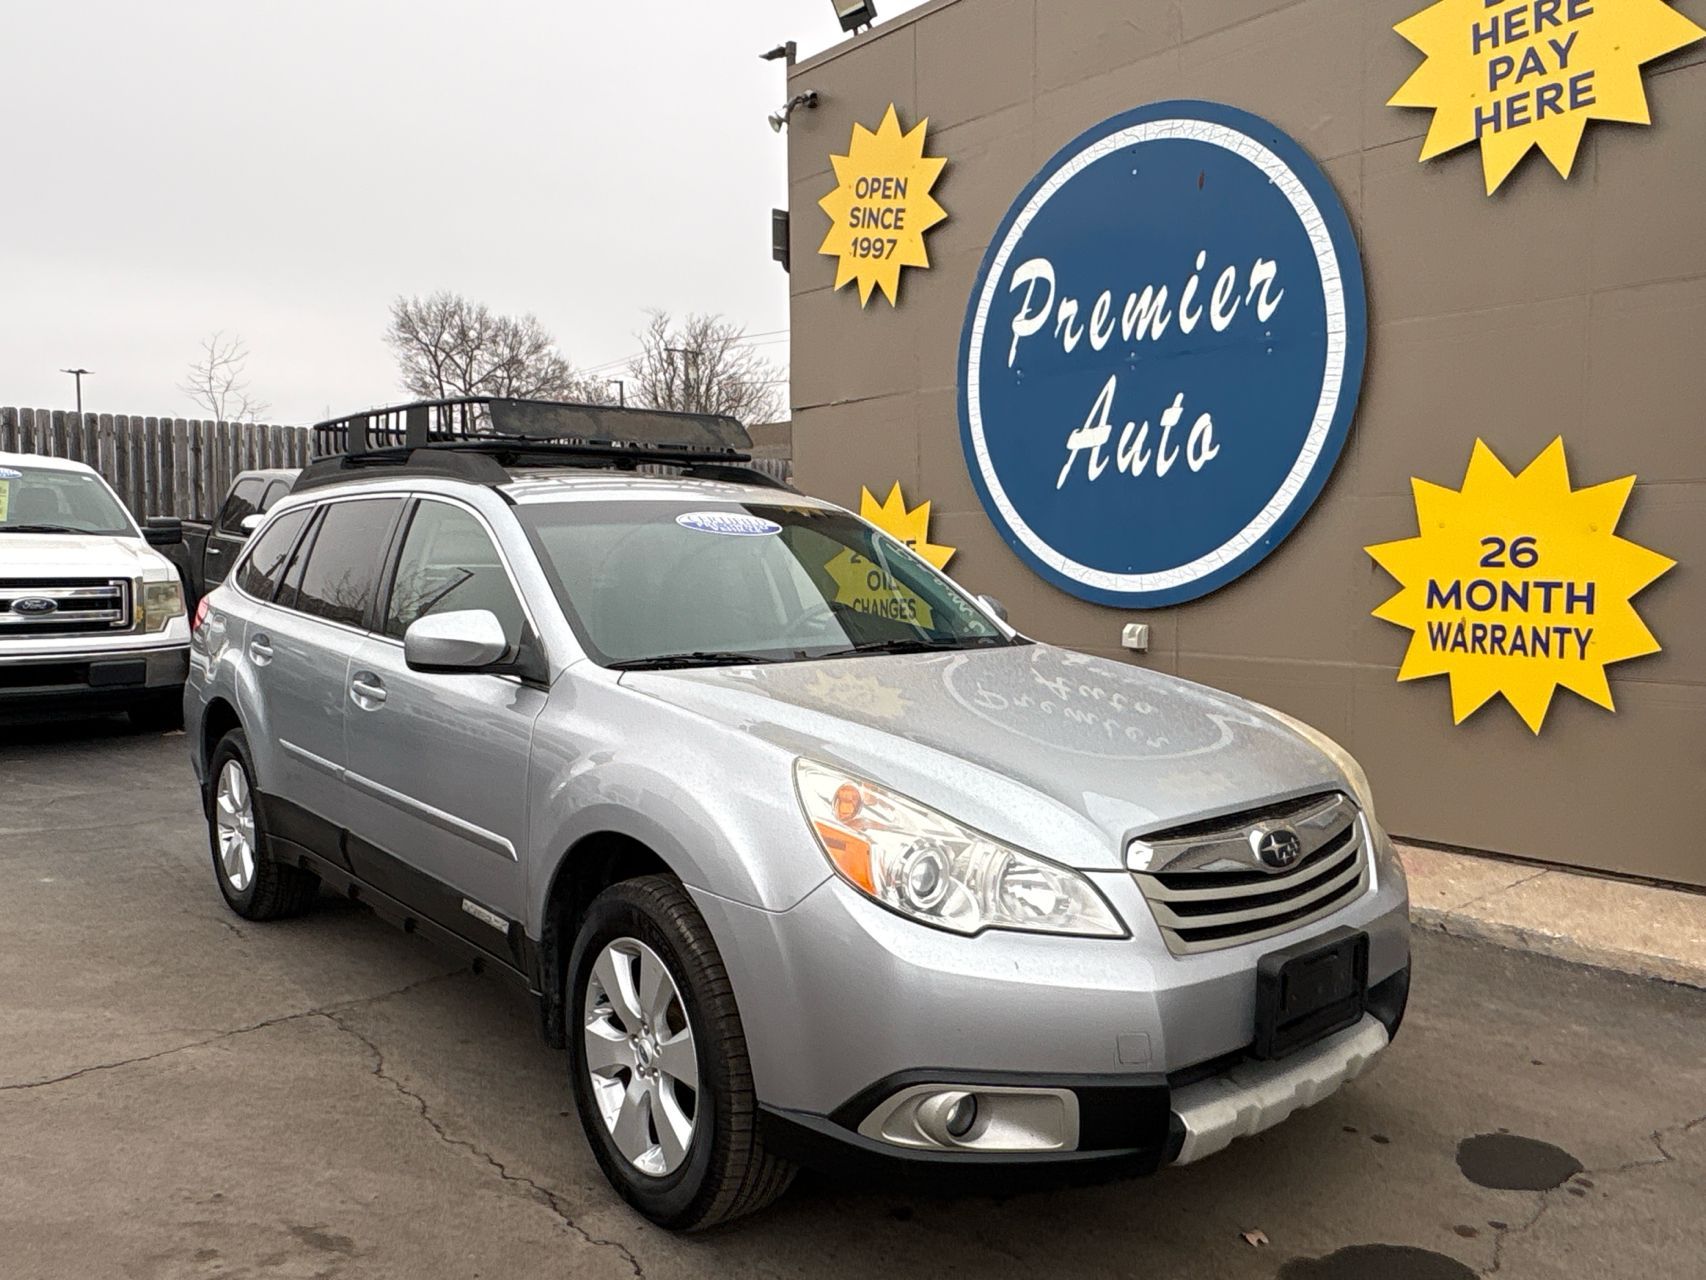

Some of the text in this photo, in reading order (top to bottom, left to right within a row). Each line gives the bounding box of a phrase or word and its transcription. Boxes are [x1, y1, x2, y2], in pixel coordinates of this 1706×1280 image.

[1472, 0, 1594, 55] HERE
[1489, 31, 1579, 92] PAY
[1474, 70, 1596, 138] HERE
[855, 177, 908, 200] OPEN
[849, 207, 906, 230] SINCE
[851, 237, 898, 260] 1997
[1008, 250, 1284, 368] Premier
[1056, 374, 1220, 490] Auto
[1479, 536, 1539, 569] 26
[867, 570, 900, 591] OIL
[1426, 579, 1595, 615] MONTH
[853, 598, 916, 620] CHANGES
[1427, 621, 1594, 661] WARRANTY
